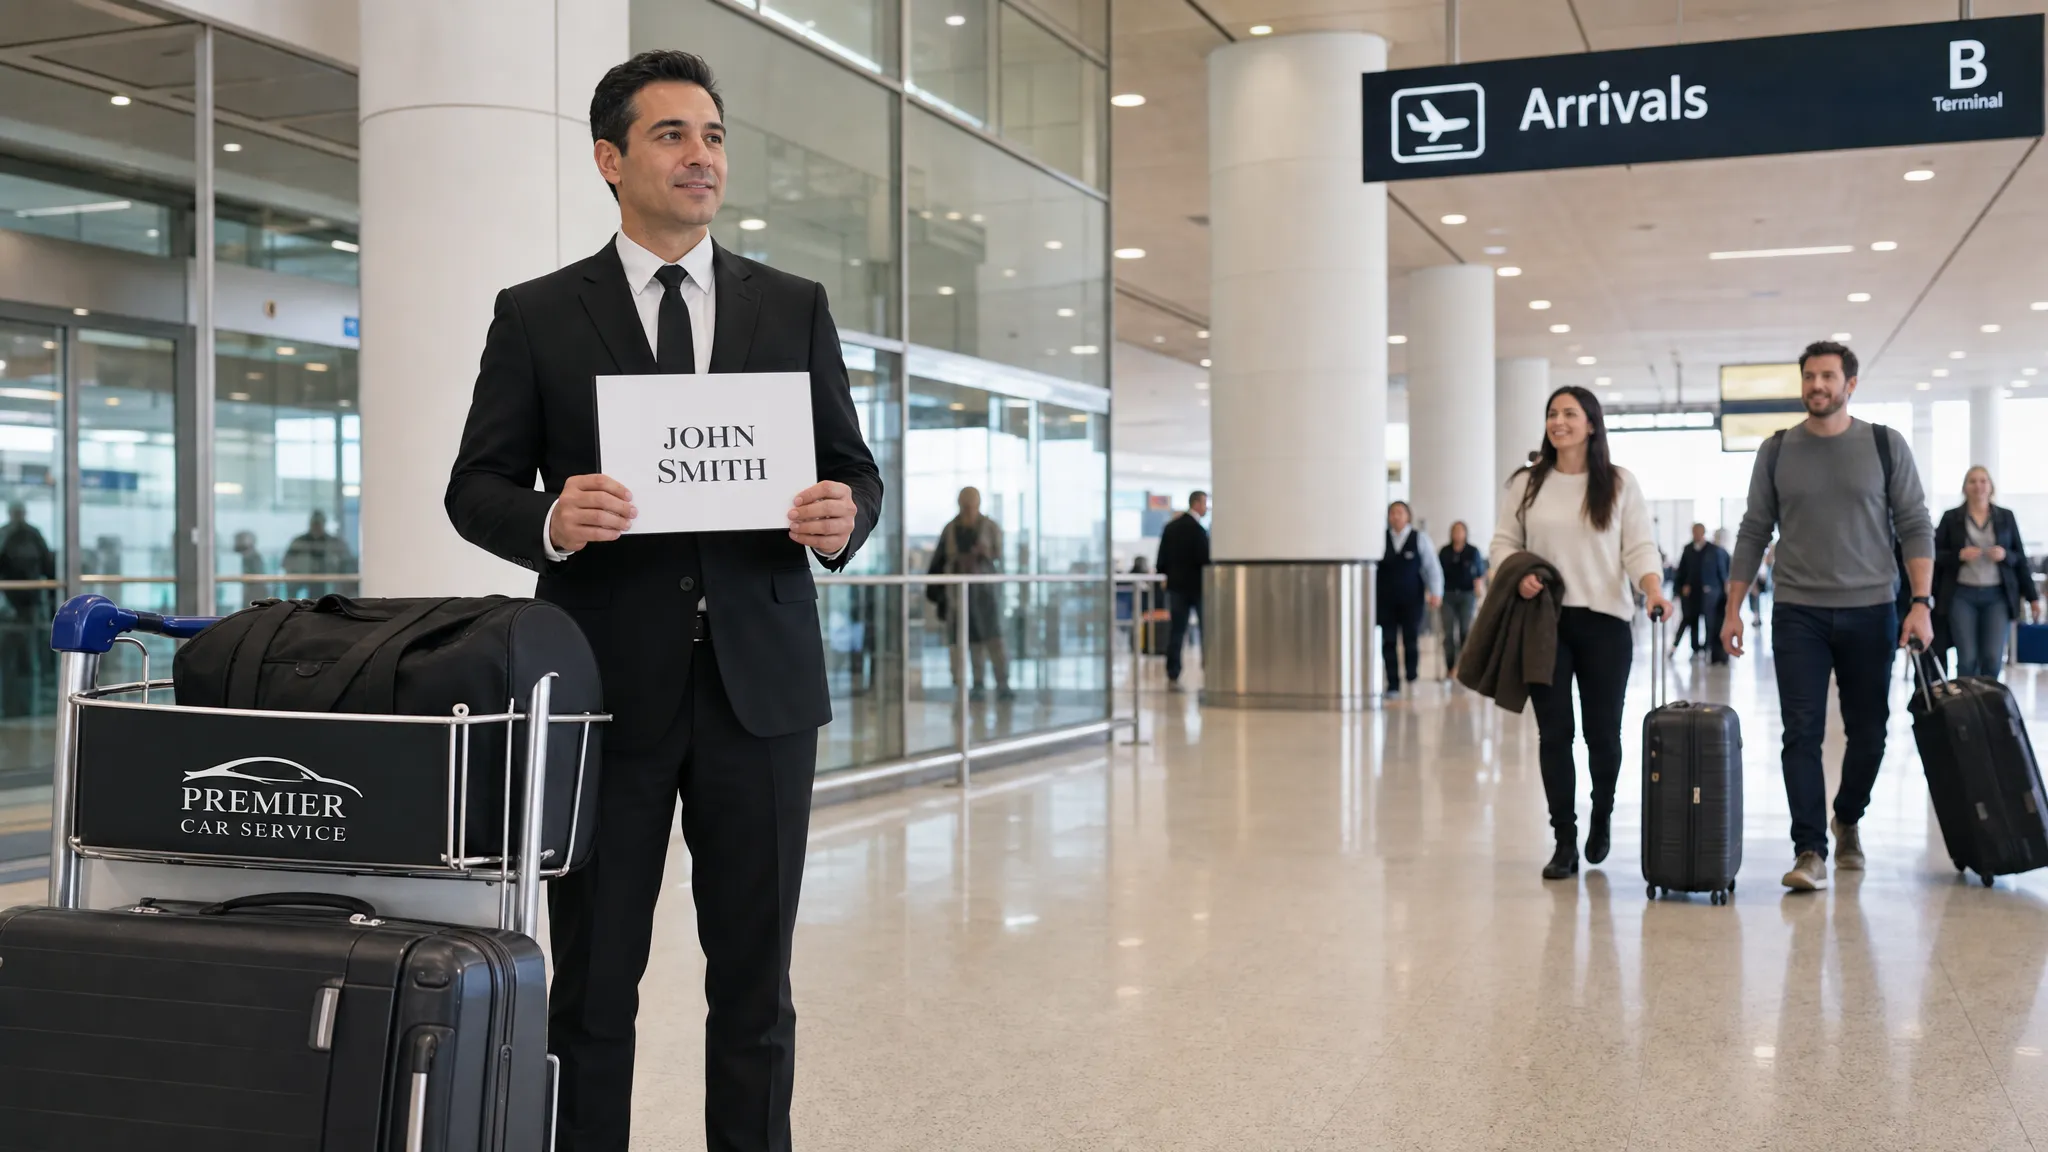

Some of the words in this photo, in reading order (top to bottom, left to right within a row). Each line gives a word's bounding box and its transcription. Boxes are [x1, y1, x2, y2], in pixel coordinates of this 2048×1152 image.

[1949, 39, 1988, 90] B
[1518, 74, 1709, 132] Arrivals
[1931, 91, 2004, 112] Terminal
[663, 425, 756, 451] JOHN
[657, 458, 767, 484] SMITH
[181, 786, 347, 819] PREMIER
[180, 818, 230, 836] CAR
[240, 822, 347, 842] SERVICE
